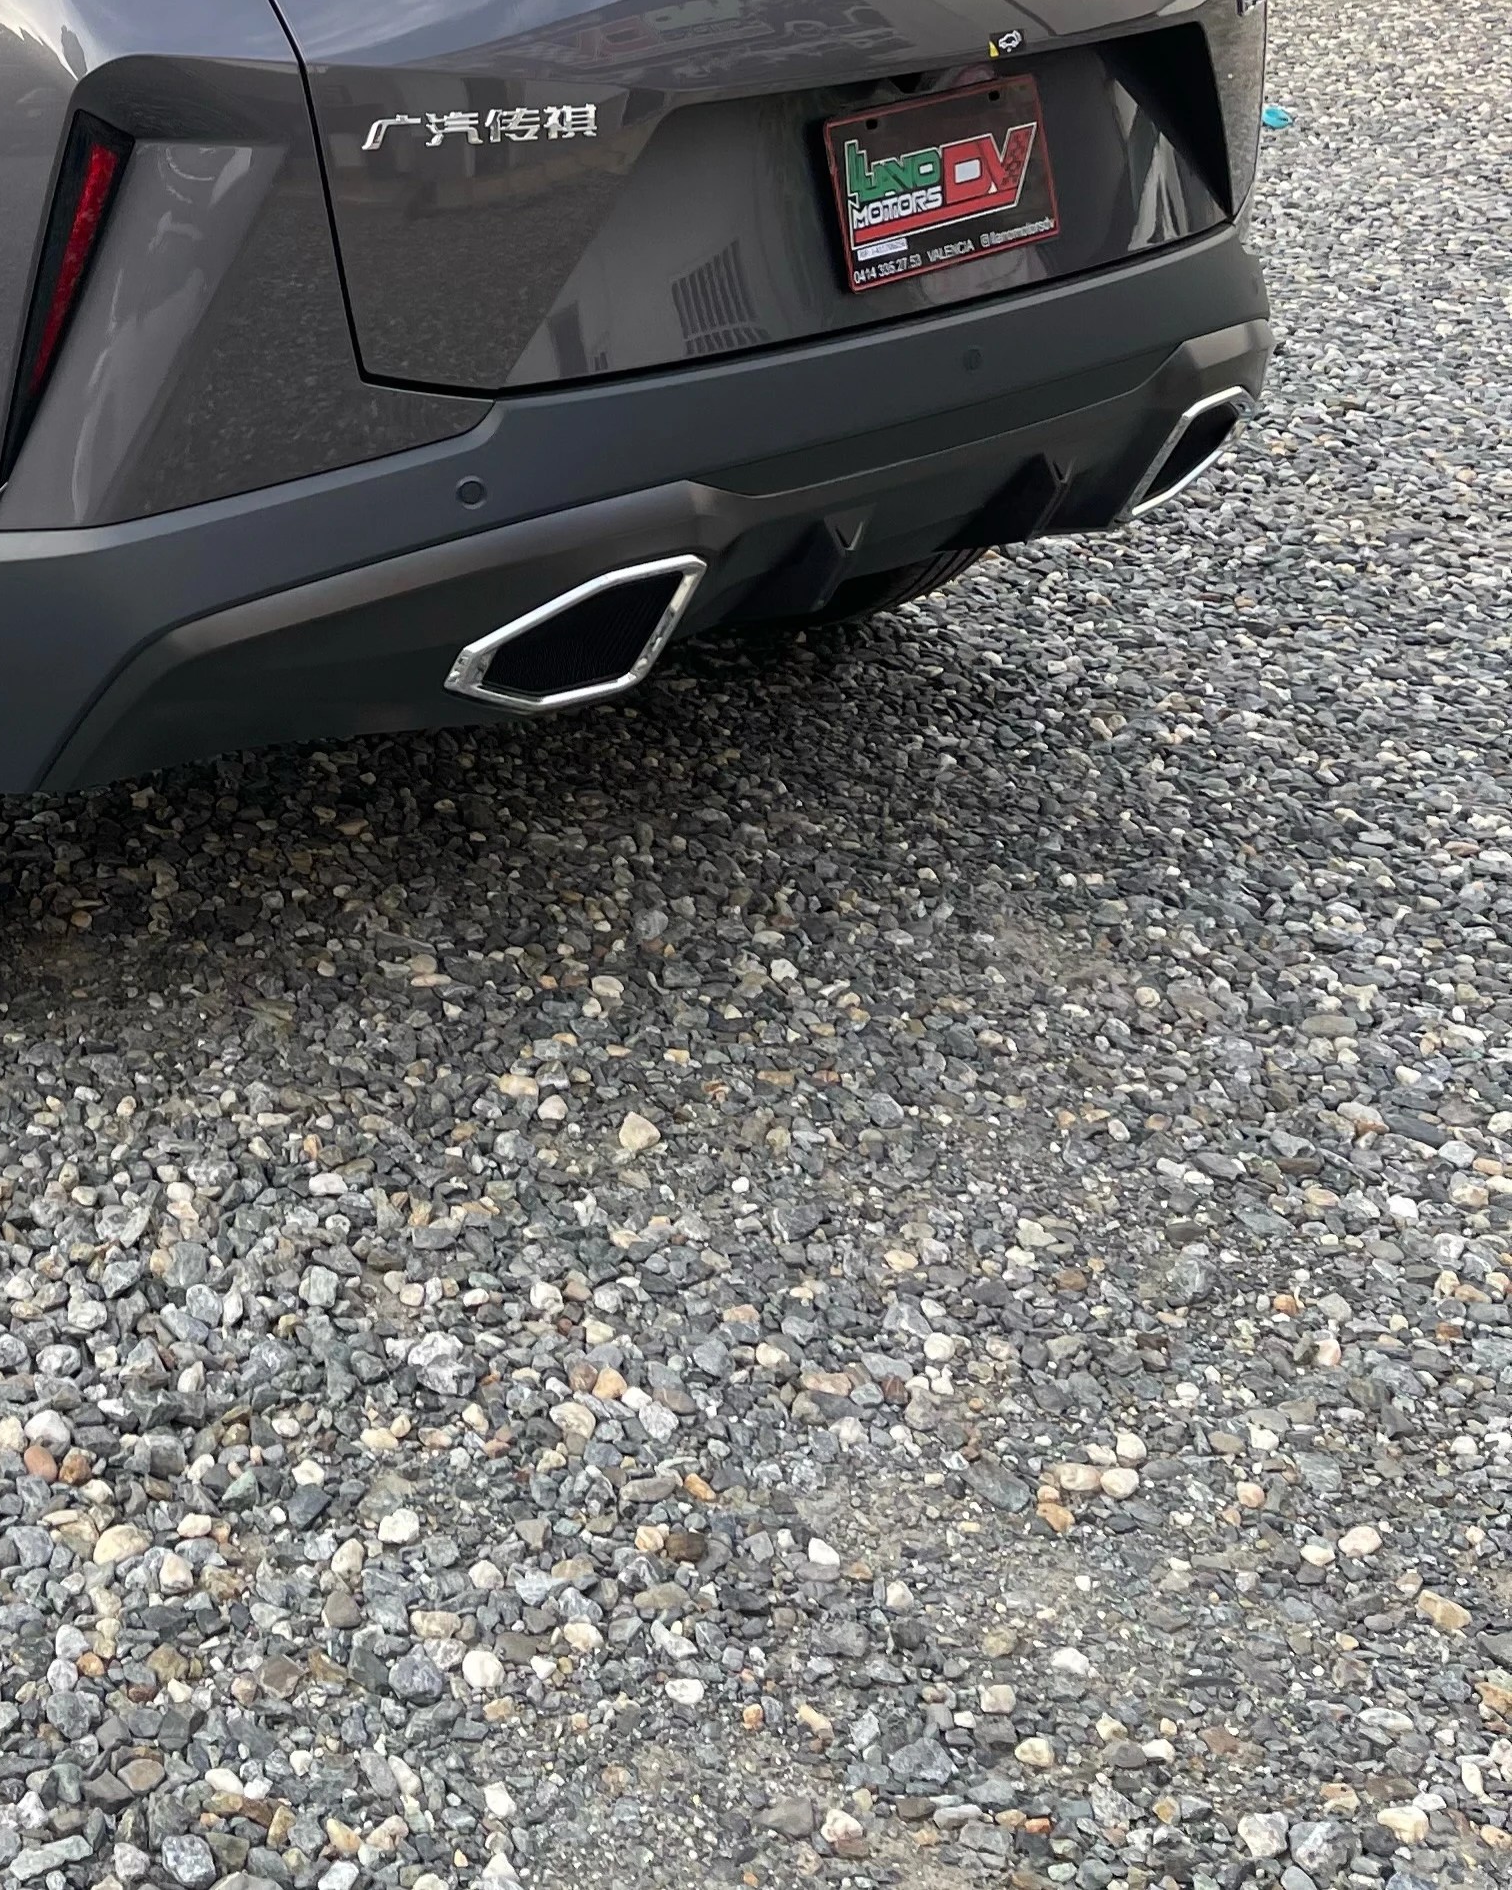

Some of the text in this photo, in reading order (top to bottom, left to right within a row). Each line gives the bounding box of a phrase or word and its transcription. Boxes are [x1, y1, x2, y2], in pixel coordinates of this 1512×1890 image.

[361, 103, 598, 151] 广汽传祺
[853, 185, 943, 229] MOTORS
[926, 238, 976, 263] VALENCIA
